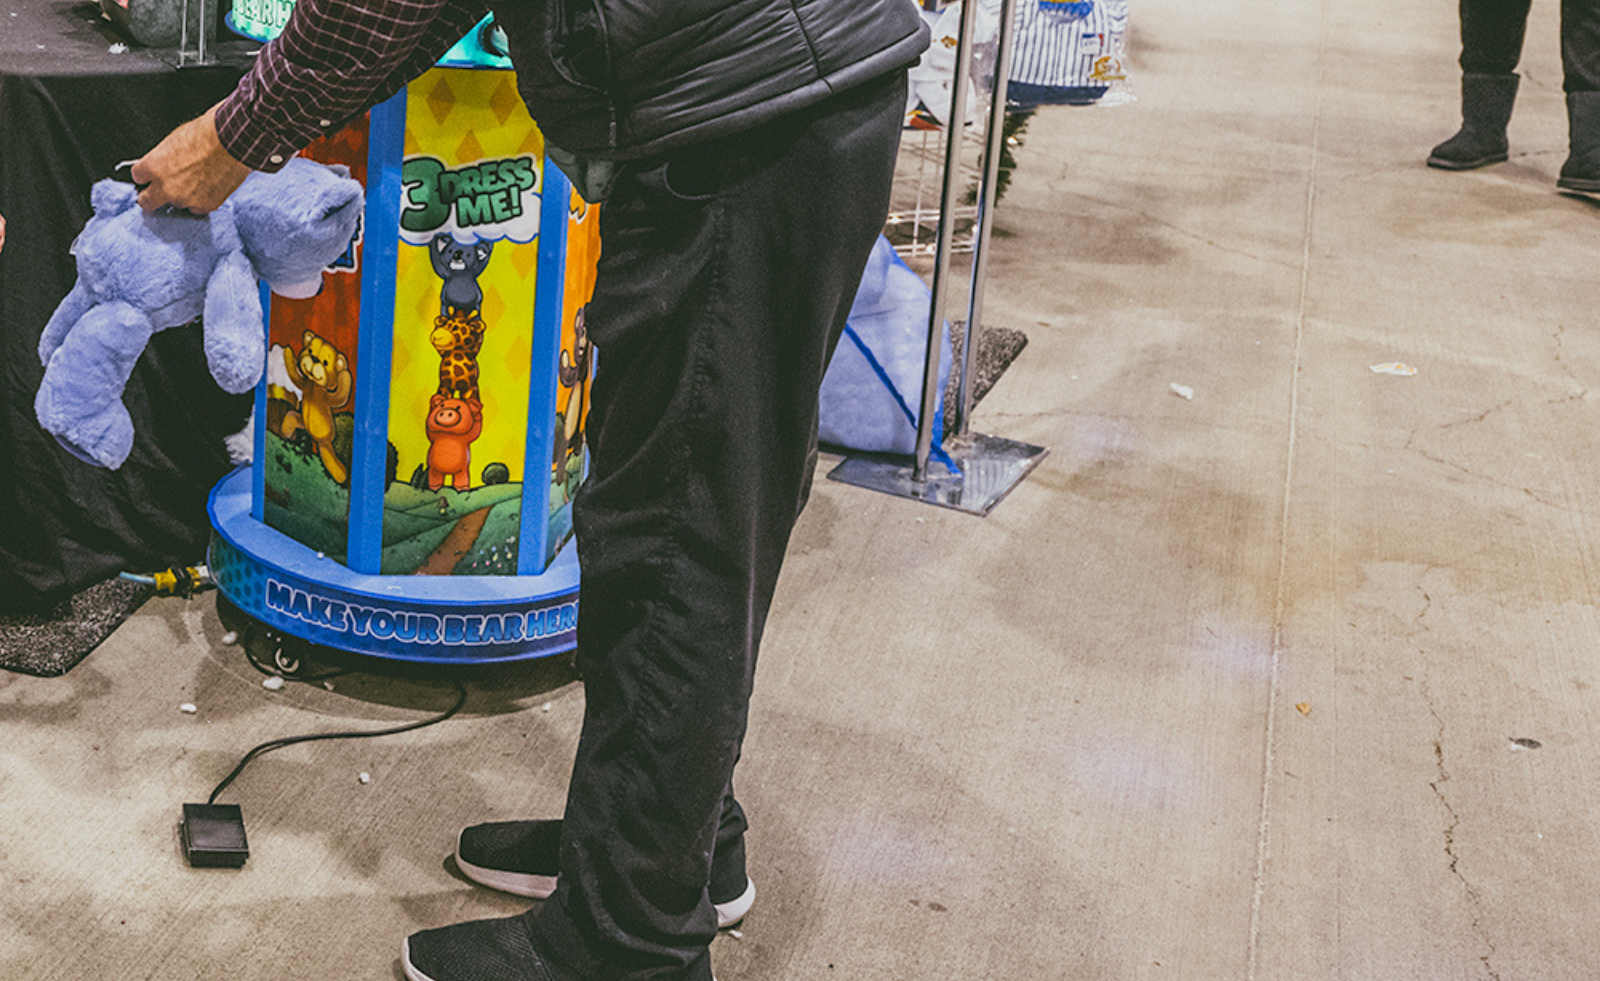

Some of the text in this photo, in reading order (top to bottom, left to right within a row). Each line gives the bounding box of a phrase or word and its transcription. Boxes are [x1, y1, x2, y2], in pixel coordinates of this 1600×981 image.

[400, 156, 537, 232] 3 DRESS
[455, 184, 523, 229] ME!
[266, 578, 347, 631] MAKE
[344, 605, 443, 644] YOUR
[442, 615, 525, 646] BEAR
